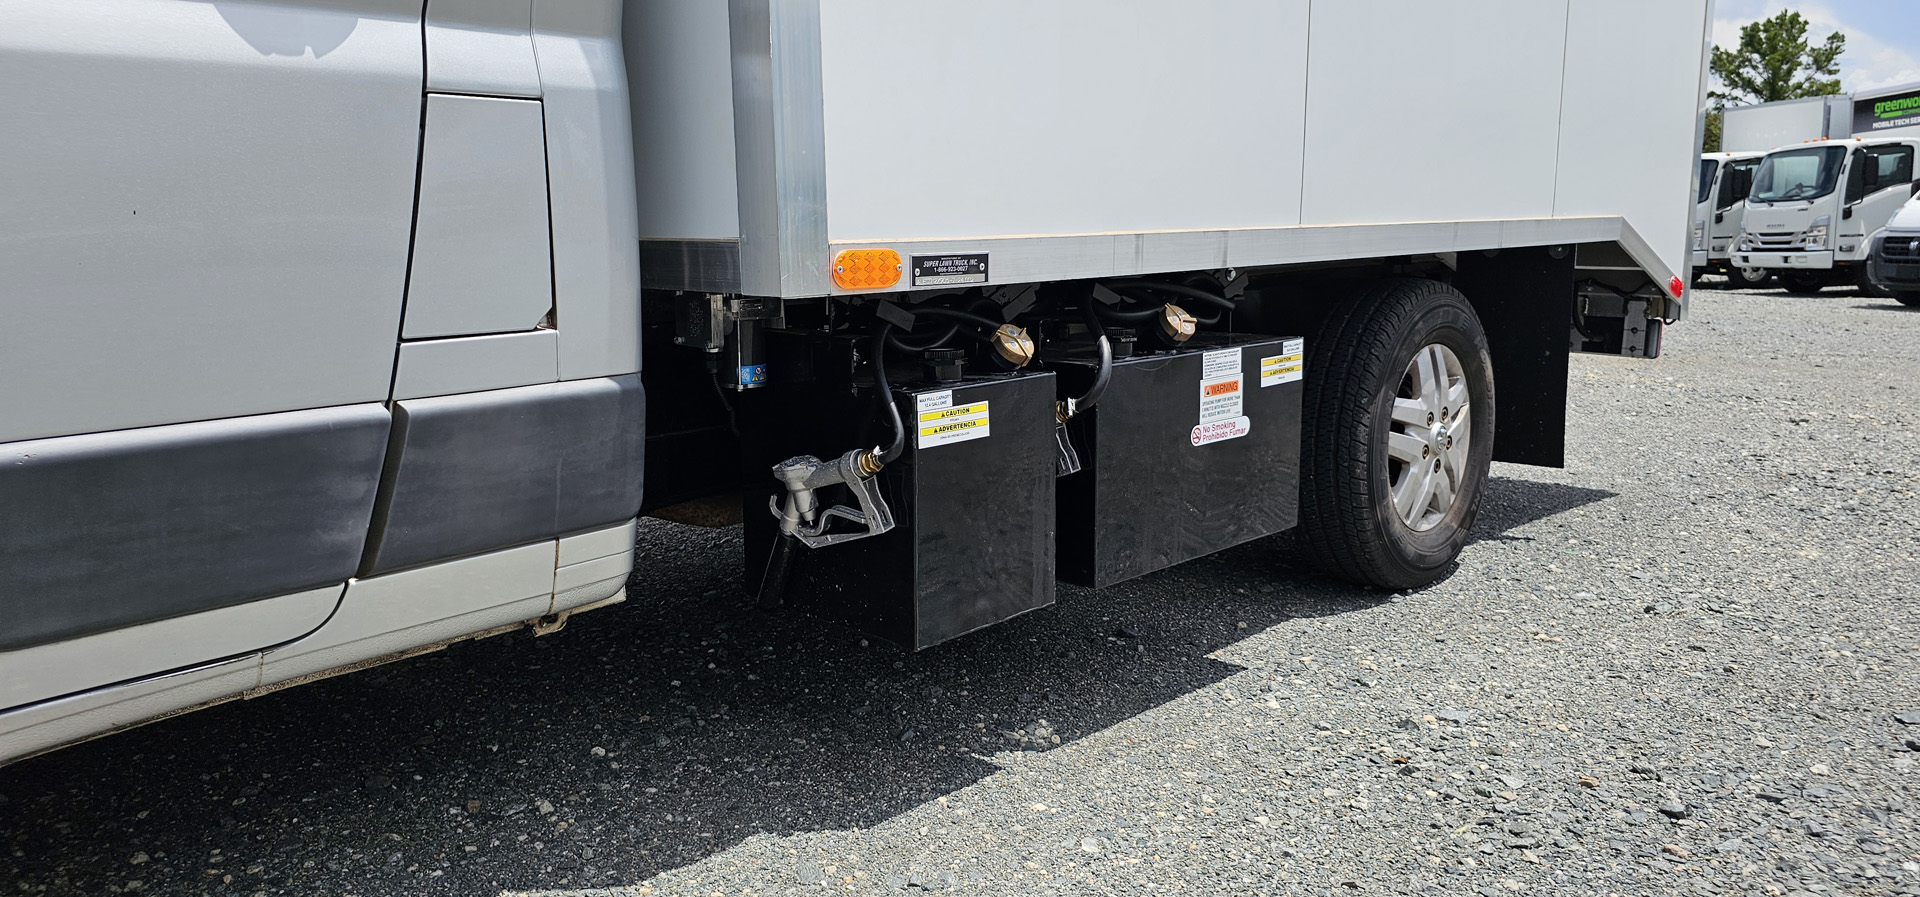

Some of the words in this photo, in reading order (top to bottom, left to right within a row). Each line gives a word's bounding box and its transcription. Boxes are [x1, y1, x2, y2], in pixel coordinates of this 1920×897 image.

[1872, 120, 1894, 129] MOBILE
[1894, 118, 1910, 126] TECH
[1210, 382, 1238, 395] WARNING
[946, 408, 970, 416] CAUTION
[938, 421, 976, 432] ADVERTENCIA
[1212, 421, 1236, 431] Smoking
[1202, 431, 1228, 442] Prohibido
[1229, 428, 1246, 436] Fumar
